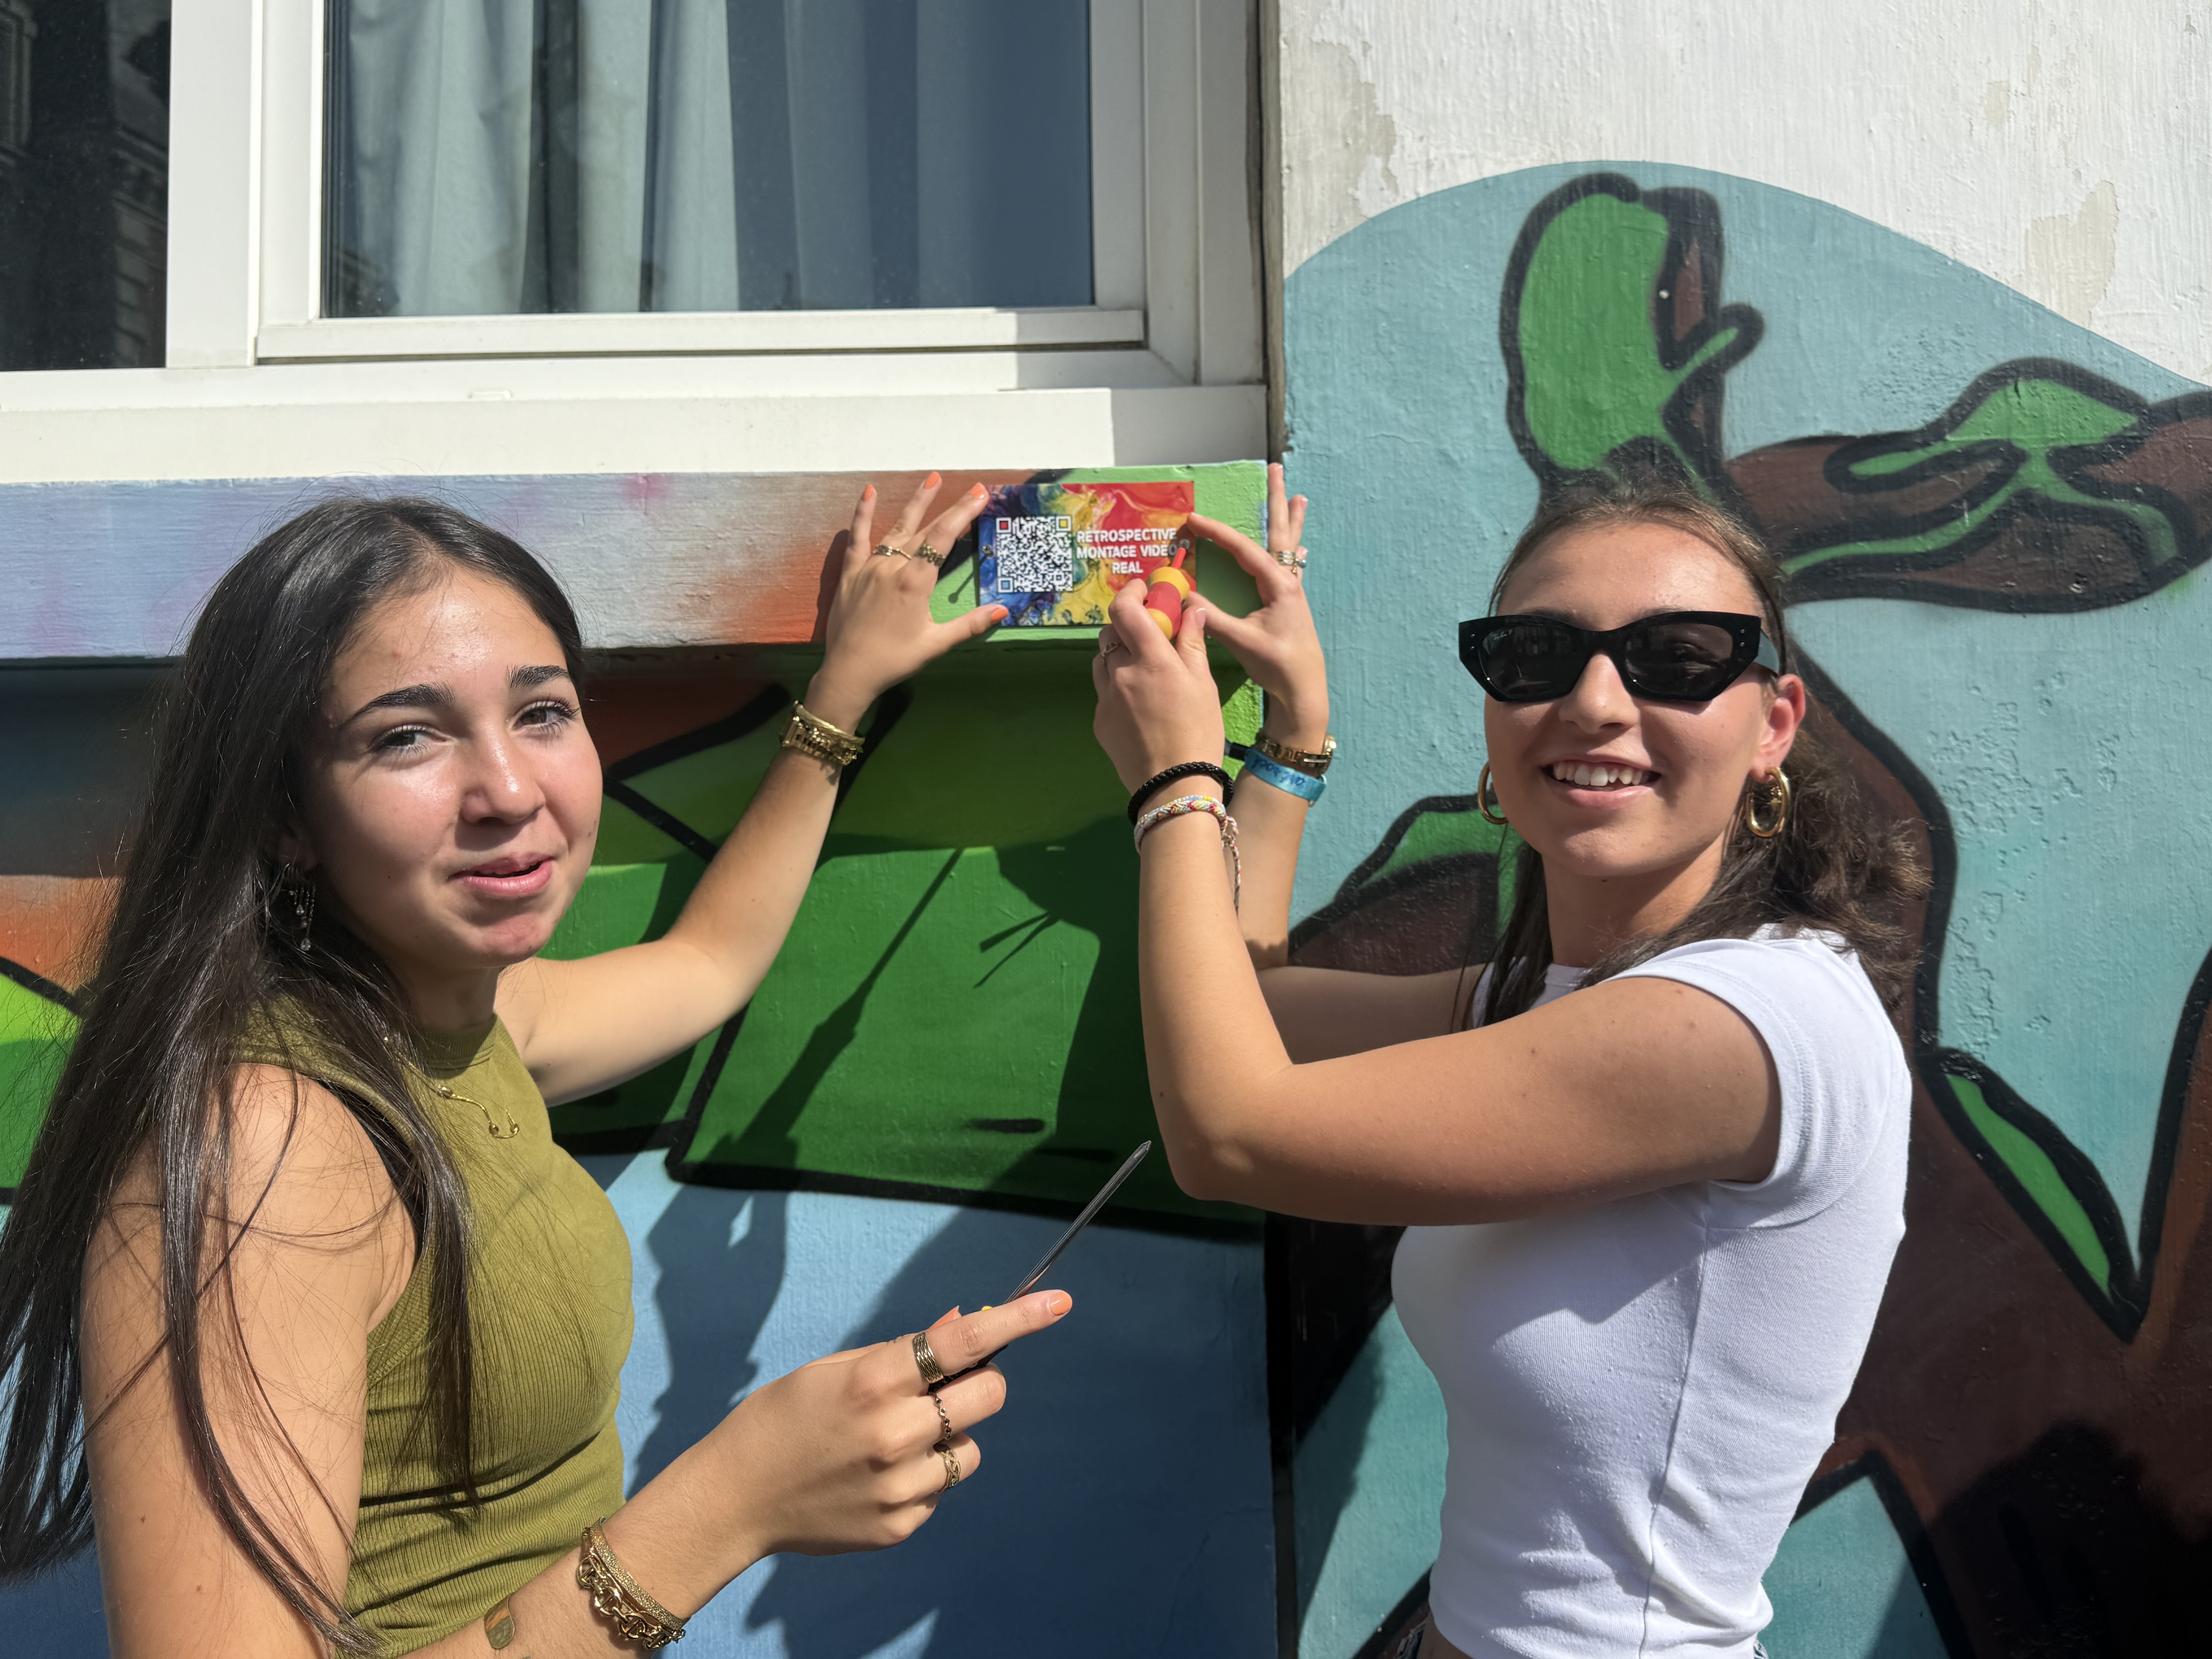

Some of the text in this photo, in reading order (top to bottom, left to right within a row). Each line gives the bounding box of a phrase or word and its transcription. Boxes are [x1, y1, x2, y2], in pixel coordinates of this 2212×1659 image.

[1077, 541, 1178, 559] MONTAGE VIDÉO
[1112, 561, 1144, 574] REAL
